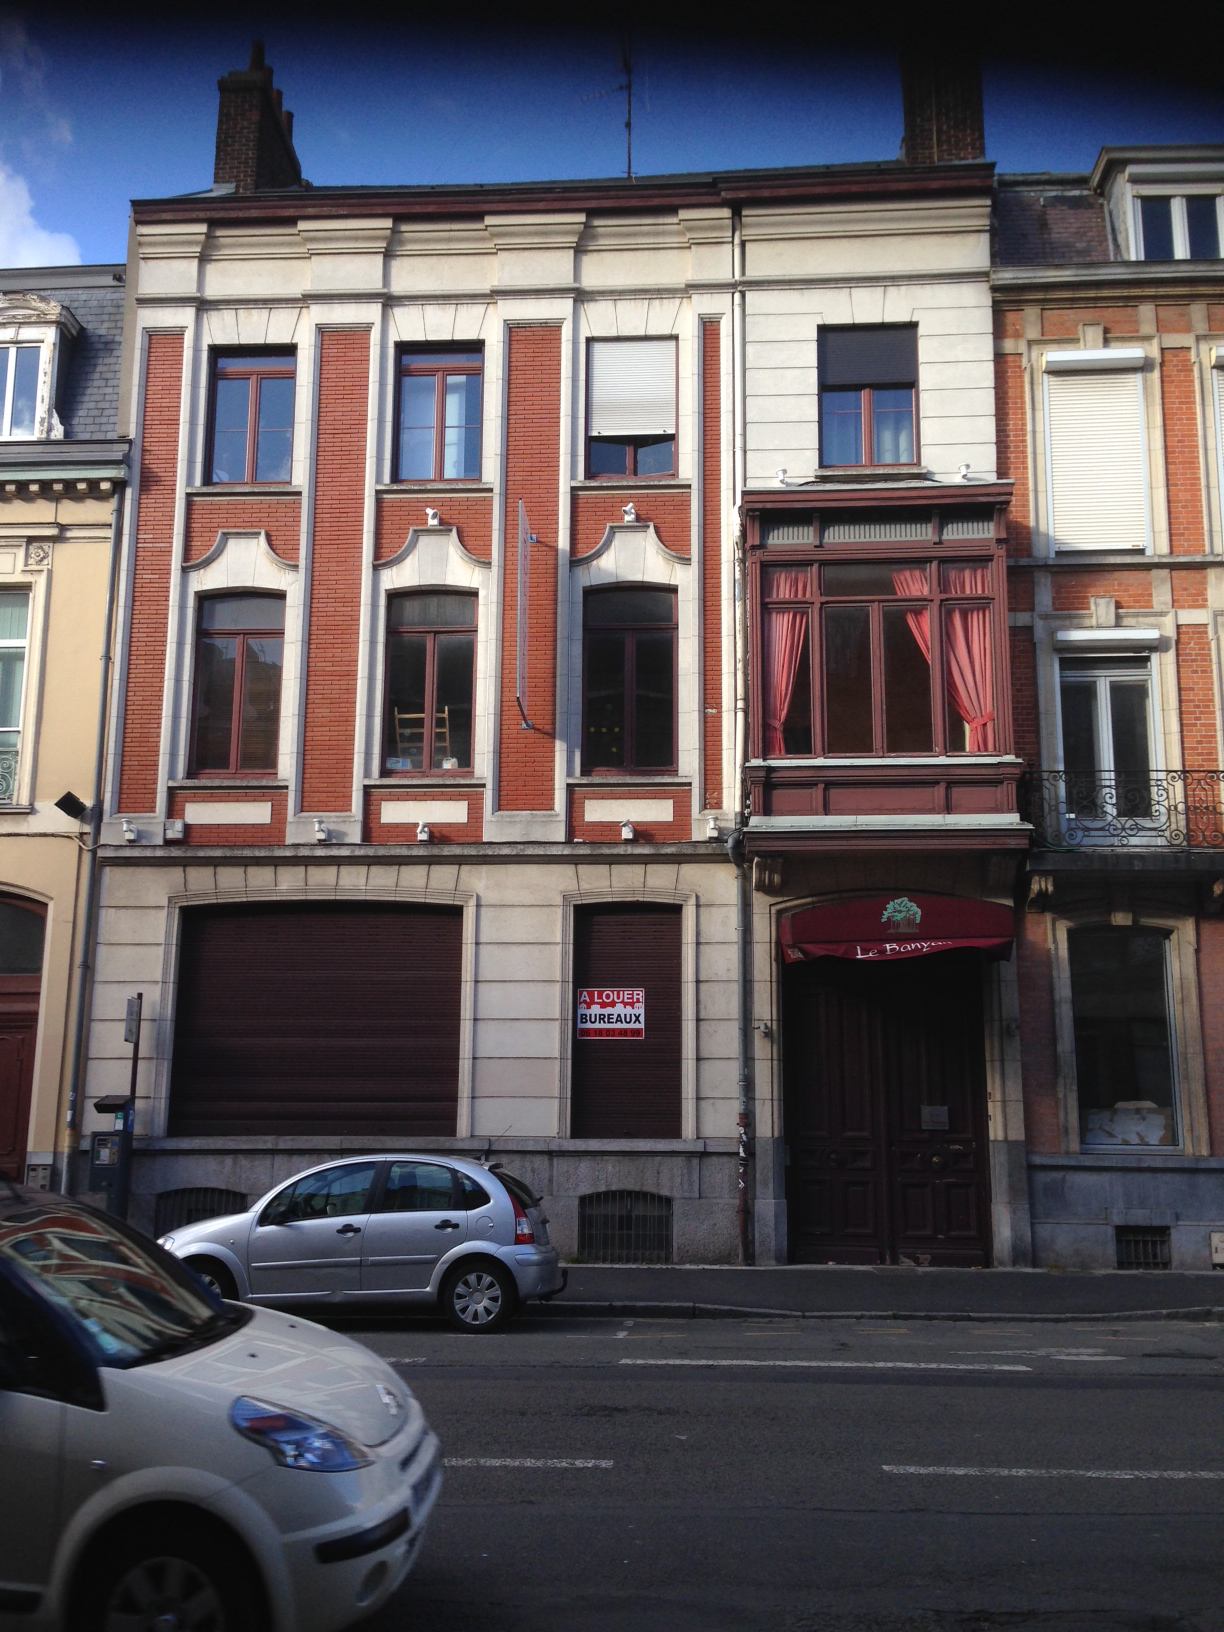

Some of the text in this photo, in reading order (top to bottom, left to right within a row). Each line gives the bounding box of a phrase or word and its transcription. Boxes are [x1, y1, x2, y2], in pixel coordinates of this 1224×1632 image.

[856, 946, 880, 959] Le
[580, 991, 643, 1002] A LOUER
[580, 1013, 642, 1024] BUREAUX
